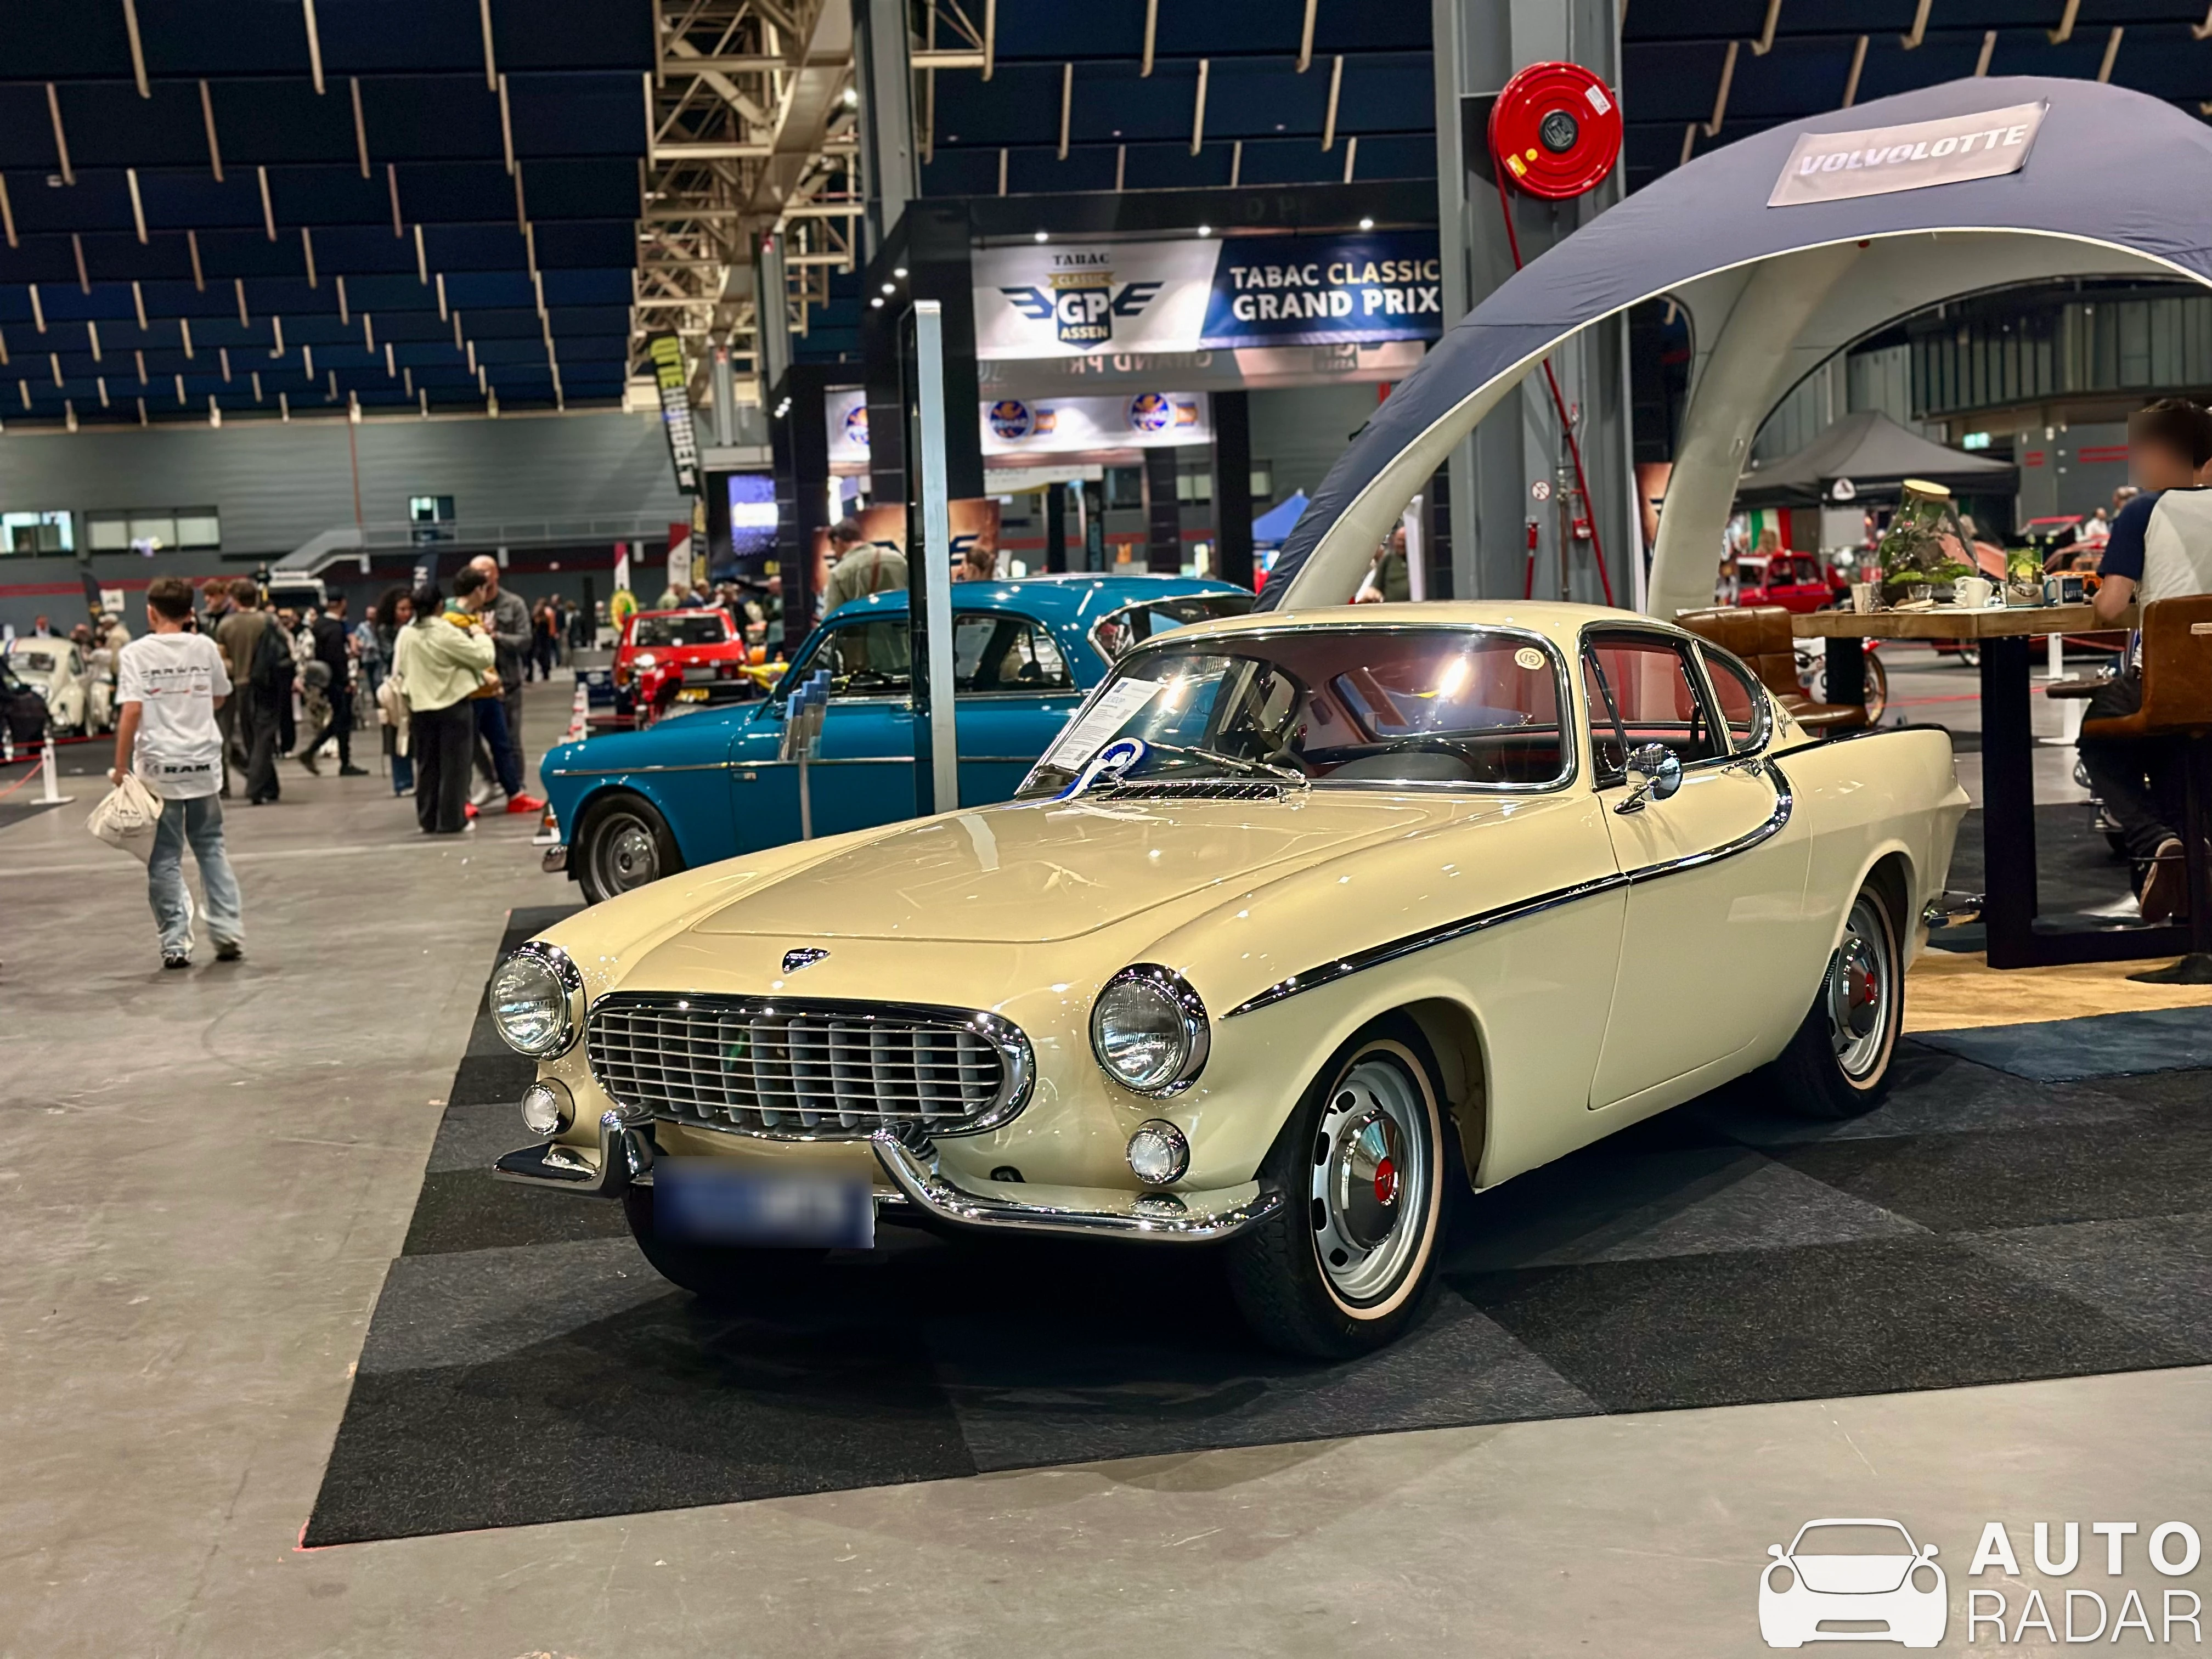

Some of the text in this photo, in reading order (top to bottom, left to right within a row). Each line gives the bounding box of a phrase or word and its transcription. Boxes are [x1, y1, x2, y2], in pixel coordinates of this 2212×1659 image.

[1799, 124, 2028, 176] VOLVOLOTTE
[1052, 253, 1110, 266] TABAC
[1058, 274, 1106, 285] CLASSIC
[1229, 259, 1441, 290] TABAC CLASSIC
[1057, 292, 1110, 325] GP
[1232, 286, 1441, 321] GRAND PRIX
[1060, 325, 1109, 340] ASSEN
[164, 764, 210, 774] RAM
